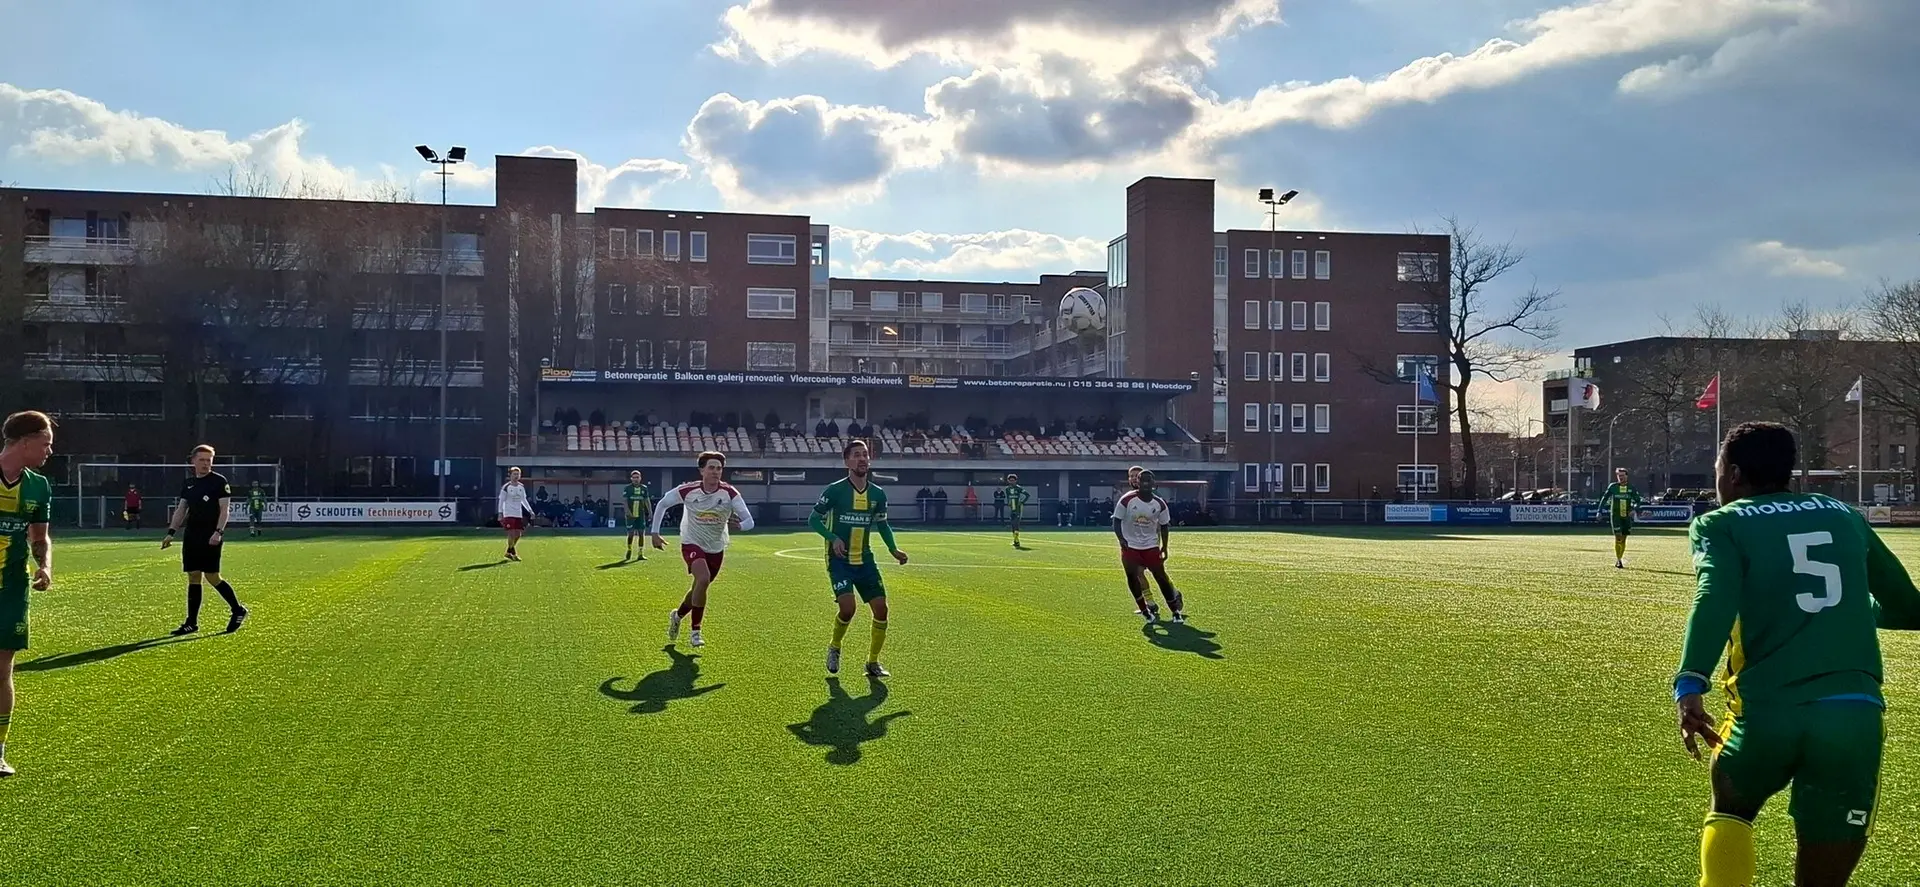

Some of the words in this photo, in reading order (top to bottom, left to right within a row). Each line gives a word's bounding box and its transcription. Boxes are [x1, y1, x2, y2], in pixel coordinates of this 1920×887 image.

[604, 371, 668, 381] Betonreparatie
[674, 372, 704, 380] Balkon
[717, 373, 744, 383] galerij
[745, 374, 785, 382] renovatie
[789, 375, 847, 385] Vloercoatings
[851, 376, 903, 385] Schilderwerk
[963, 379, 1066, 387] www.betonreparatie.nu
[1072, 380, 1092, 388] 015
[316, 507, 363, 517] SCHOUTEN
[368, 508, 433, 519] techniekgroep
[1787, 531, 1842, 613] 5
